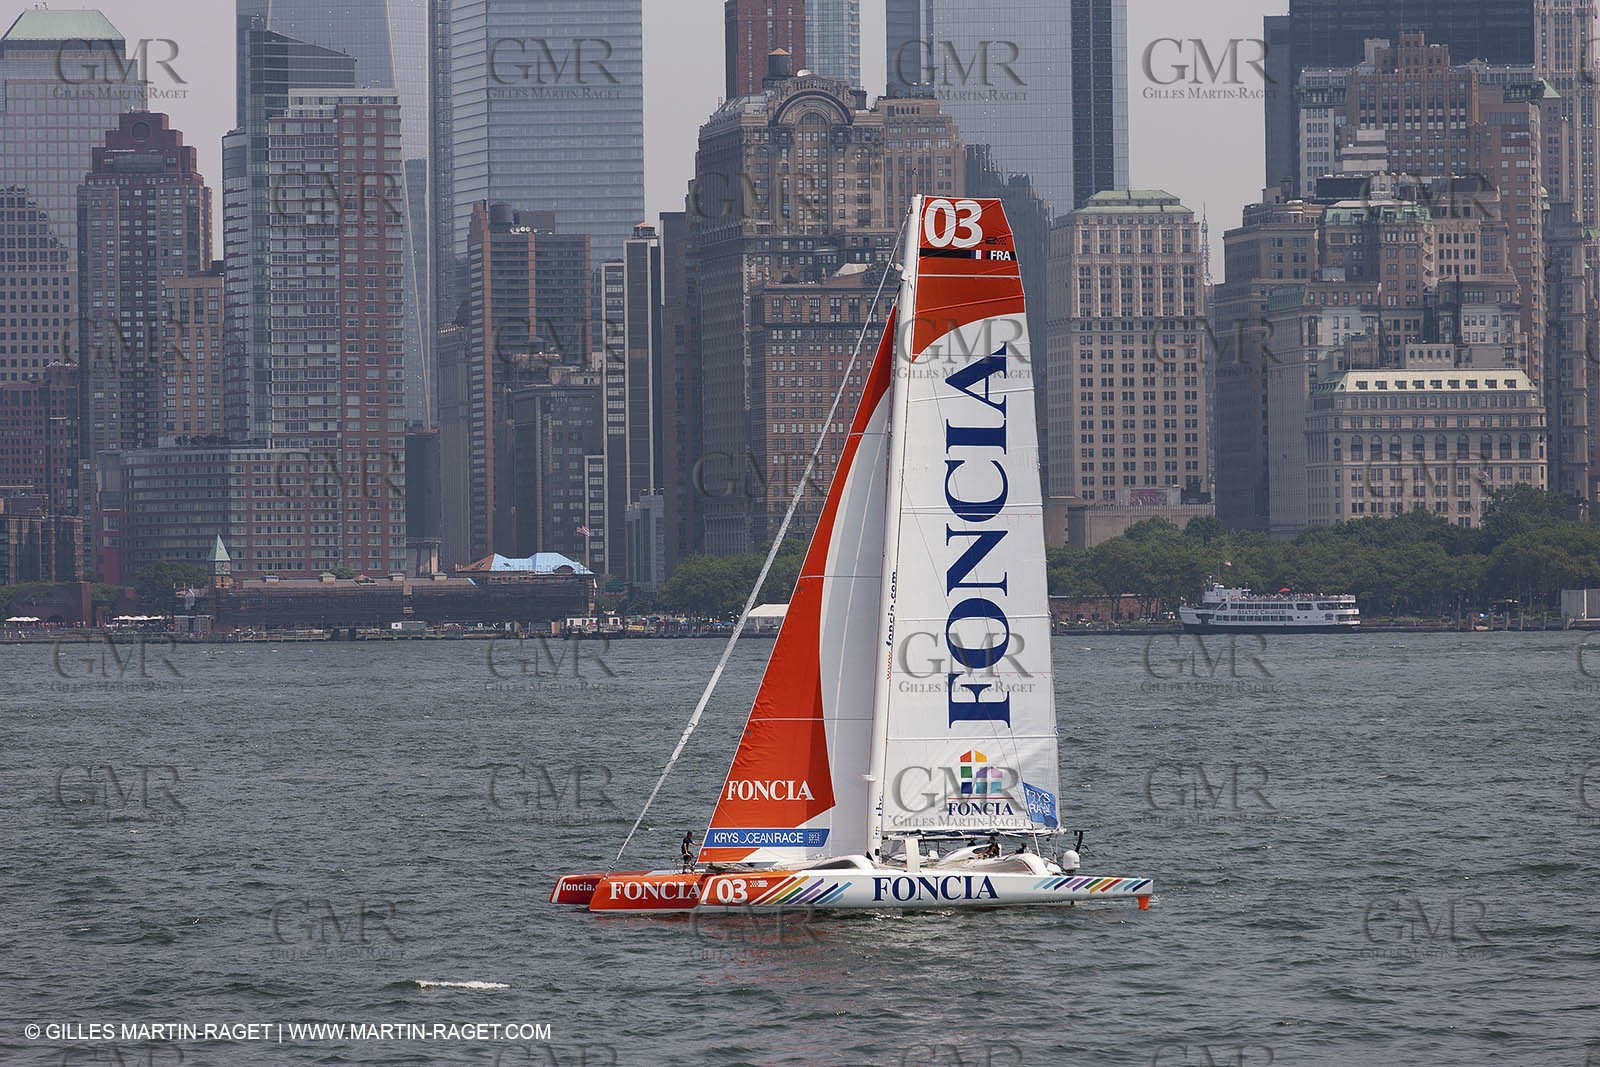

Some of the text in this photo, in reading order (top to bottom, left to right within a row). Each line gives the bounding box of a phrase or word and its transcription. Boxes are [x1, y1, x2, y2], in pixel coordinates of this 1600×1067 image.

[924, 199, 983, 248] 03
[990, 250, 1011, 261] FRA
[944, 341, 1011, 729] FONCIA
[726, 780, 815, 801] FONCIA
[948, 802, 1014, 816] FONCIA
[714, 832, 739, 843] KRYS
[774, 832, 804, 843] RACE
[609, 881, 701, 900] FONCIA
[716, 878, 748, 904] 03
[872, 875, 1000, 902] FONCIA
